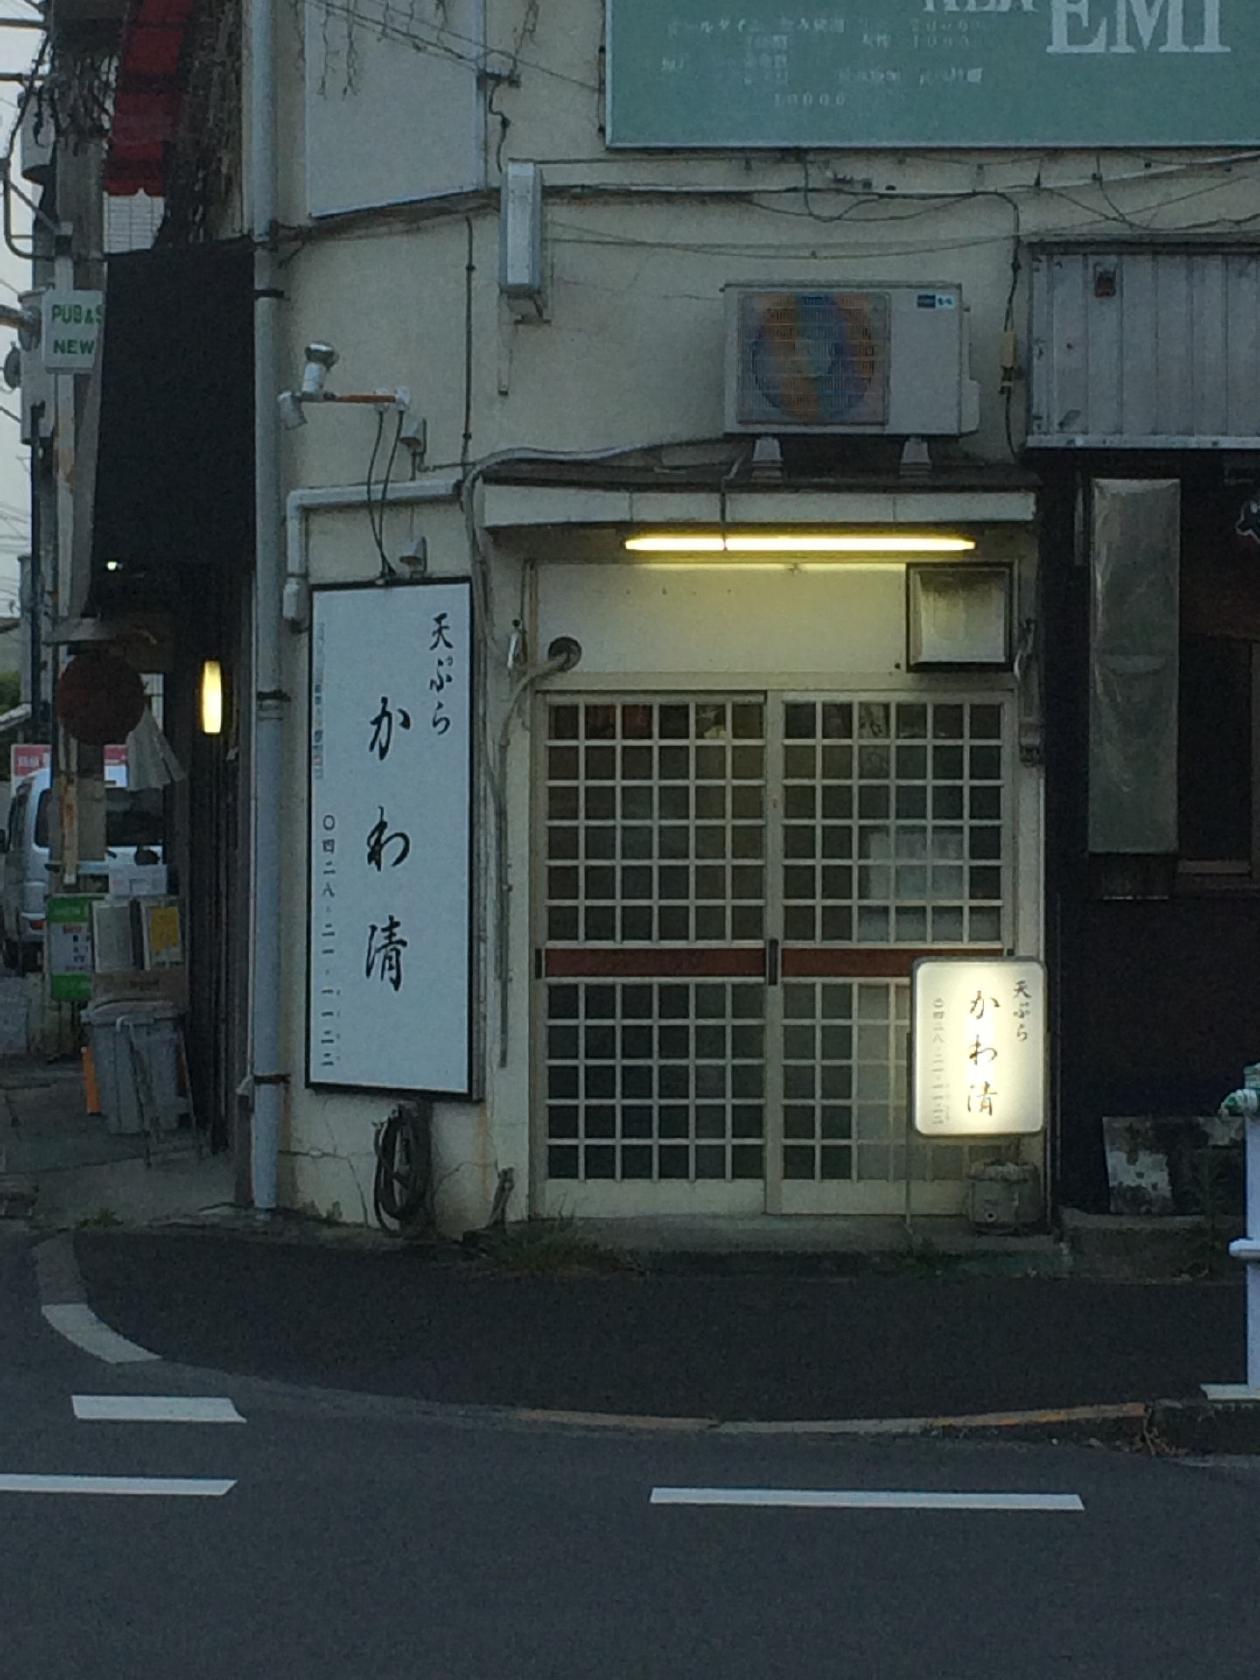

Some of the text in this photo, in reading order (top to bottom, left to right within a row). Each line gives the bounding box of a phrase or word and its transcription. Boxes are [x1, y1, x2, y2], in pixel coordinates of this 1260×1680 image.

[53, 339, 95, 354] NEW
[429, 612, 455, 736] 天ぷら
[366, 696, 412, 992] かわ清
[967, 990, 1000, 1116] かわ清
[1013, 980, 1031, 1041] 天ぷら
